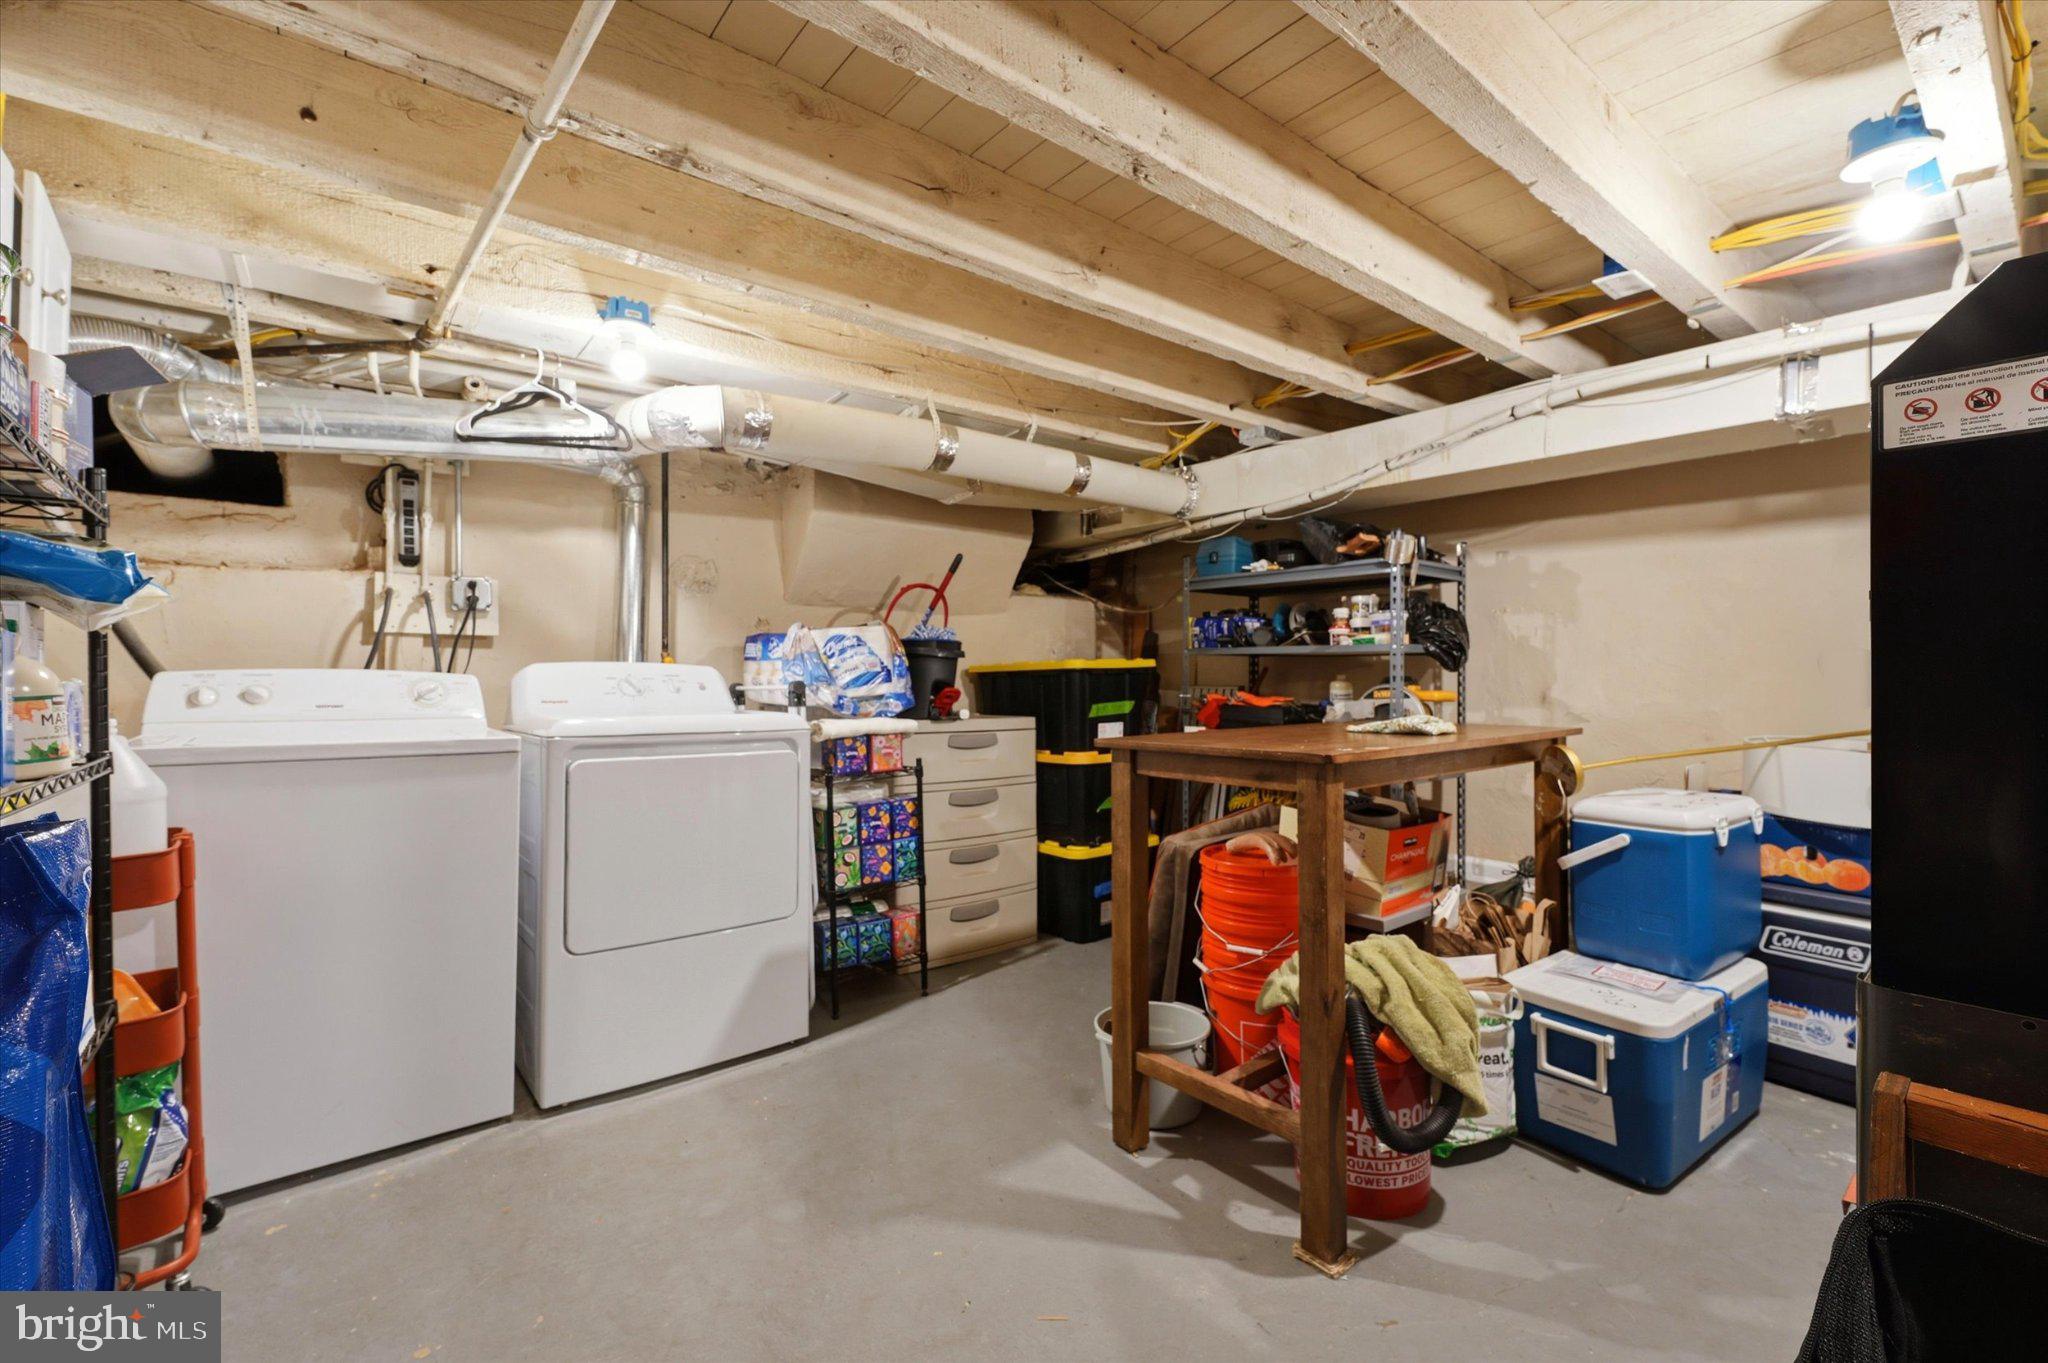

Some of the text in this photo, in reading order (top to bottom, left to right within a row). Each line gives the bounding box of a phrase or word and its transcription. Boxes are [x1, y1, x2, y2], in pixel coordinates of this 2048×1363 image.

[1895, 379, 1936, 390] CAUTION:
[1937, 374, 1957, 383] Read
[1971, 365, 2014, 378] instruction
[2015, 358, 2045, 370] manual
[1976, 373, 2006, 384] manual
[1772, 931, 1844, 958] Coleman
[1347, 1157, 1402, 1172] QUALITY
[1347, 1173, 1397, 1187] LOWEST
